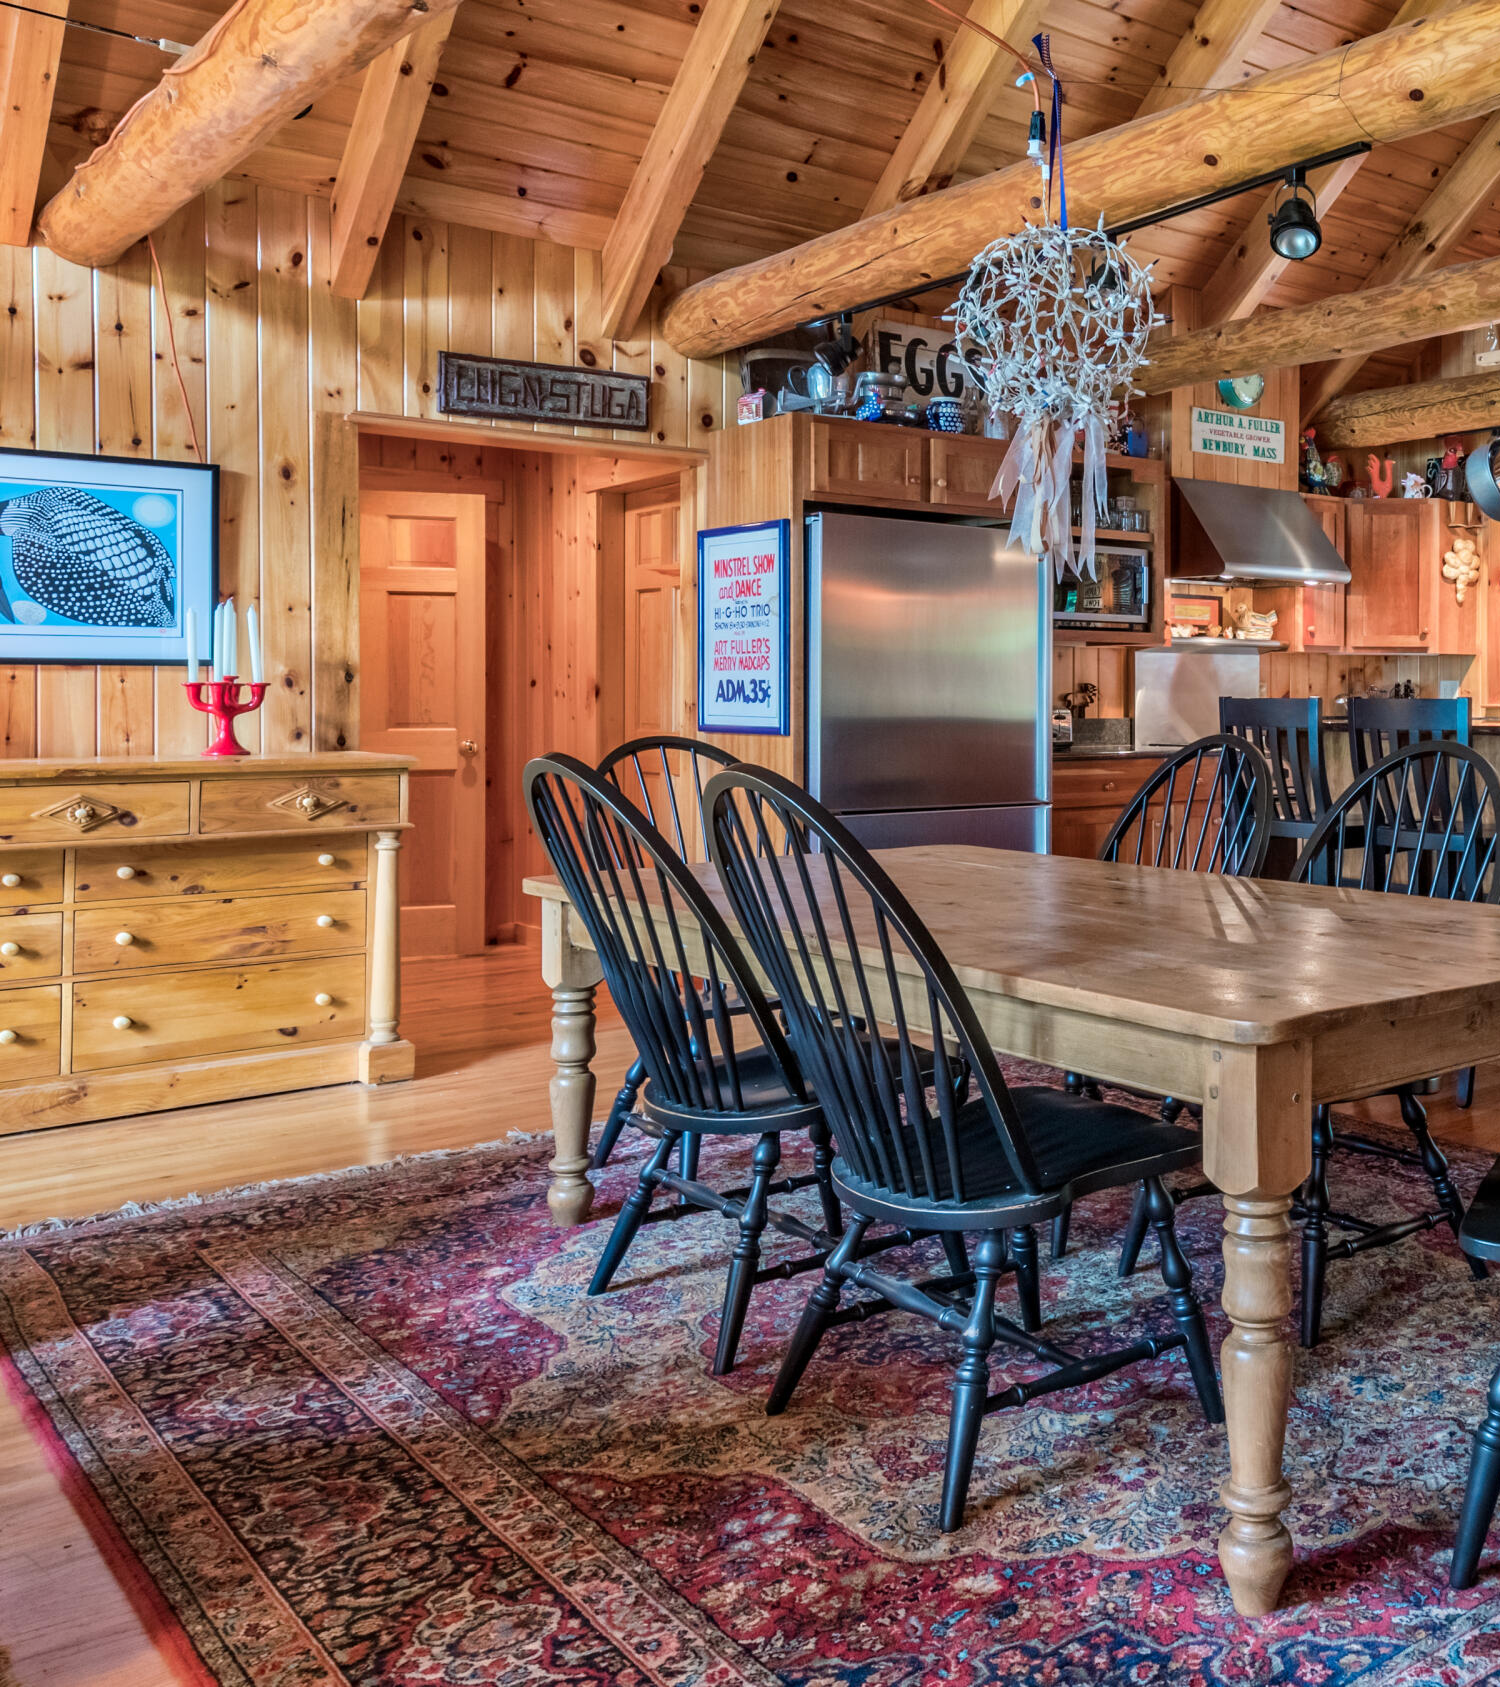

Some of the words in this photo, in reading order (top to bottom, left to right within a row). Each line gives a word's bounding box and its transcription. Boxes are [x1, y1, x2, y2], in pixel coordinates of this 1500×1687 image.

[1197, 410, 1234, 427] ARTHUR
[1238, 418, 1247, 430] A.
[1248, 419, 1280, 434] FULLER
[1209, 428, 1244, 440] VEGETABLE
[1246, 434, 1271, 443] GROWER
[1253, 446, 1277, 459] MASS
[713, 556, 751, 579] MINSTREL
[753, 553, 775, 574] SHOW
[719, 582, 734, 601] and
[735, 578, 762, 598] DANCE
[750, 603, 770, 617] TRIO
[714, 640, 728, 656] ART
[730, 637, 770, 655] FULLER'S
[713, 656, 737, 672] MERRY
[738, 655, 770, 671] MADCAPS
